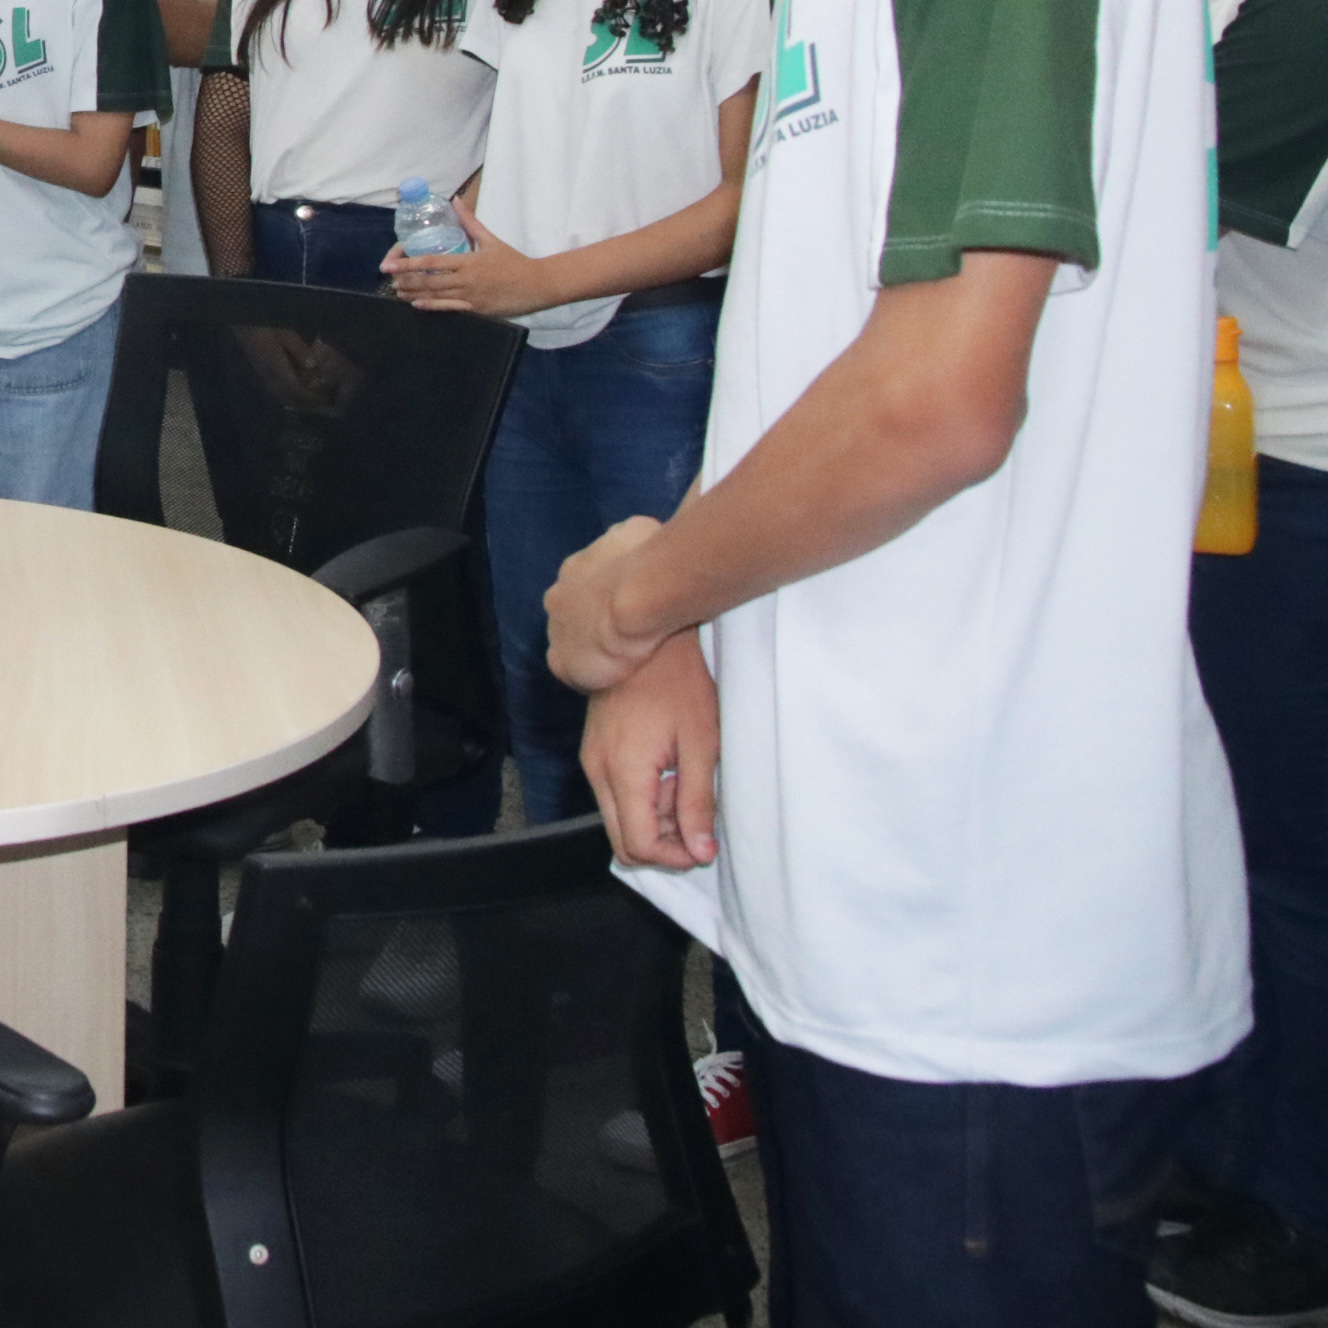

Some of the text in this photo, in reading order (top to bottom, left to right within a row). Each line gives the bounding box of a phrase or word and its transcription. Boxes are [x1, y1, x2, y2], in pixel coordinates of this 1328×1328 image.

[608, 66, 640, 75] SANTA
[643, 66, 672, 75] LUZIA
[7, 73, 31, 86] SANTA
[788, 108, 839, 137] LUZIA
